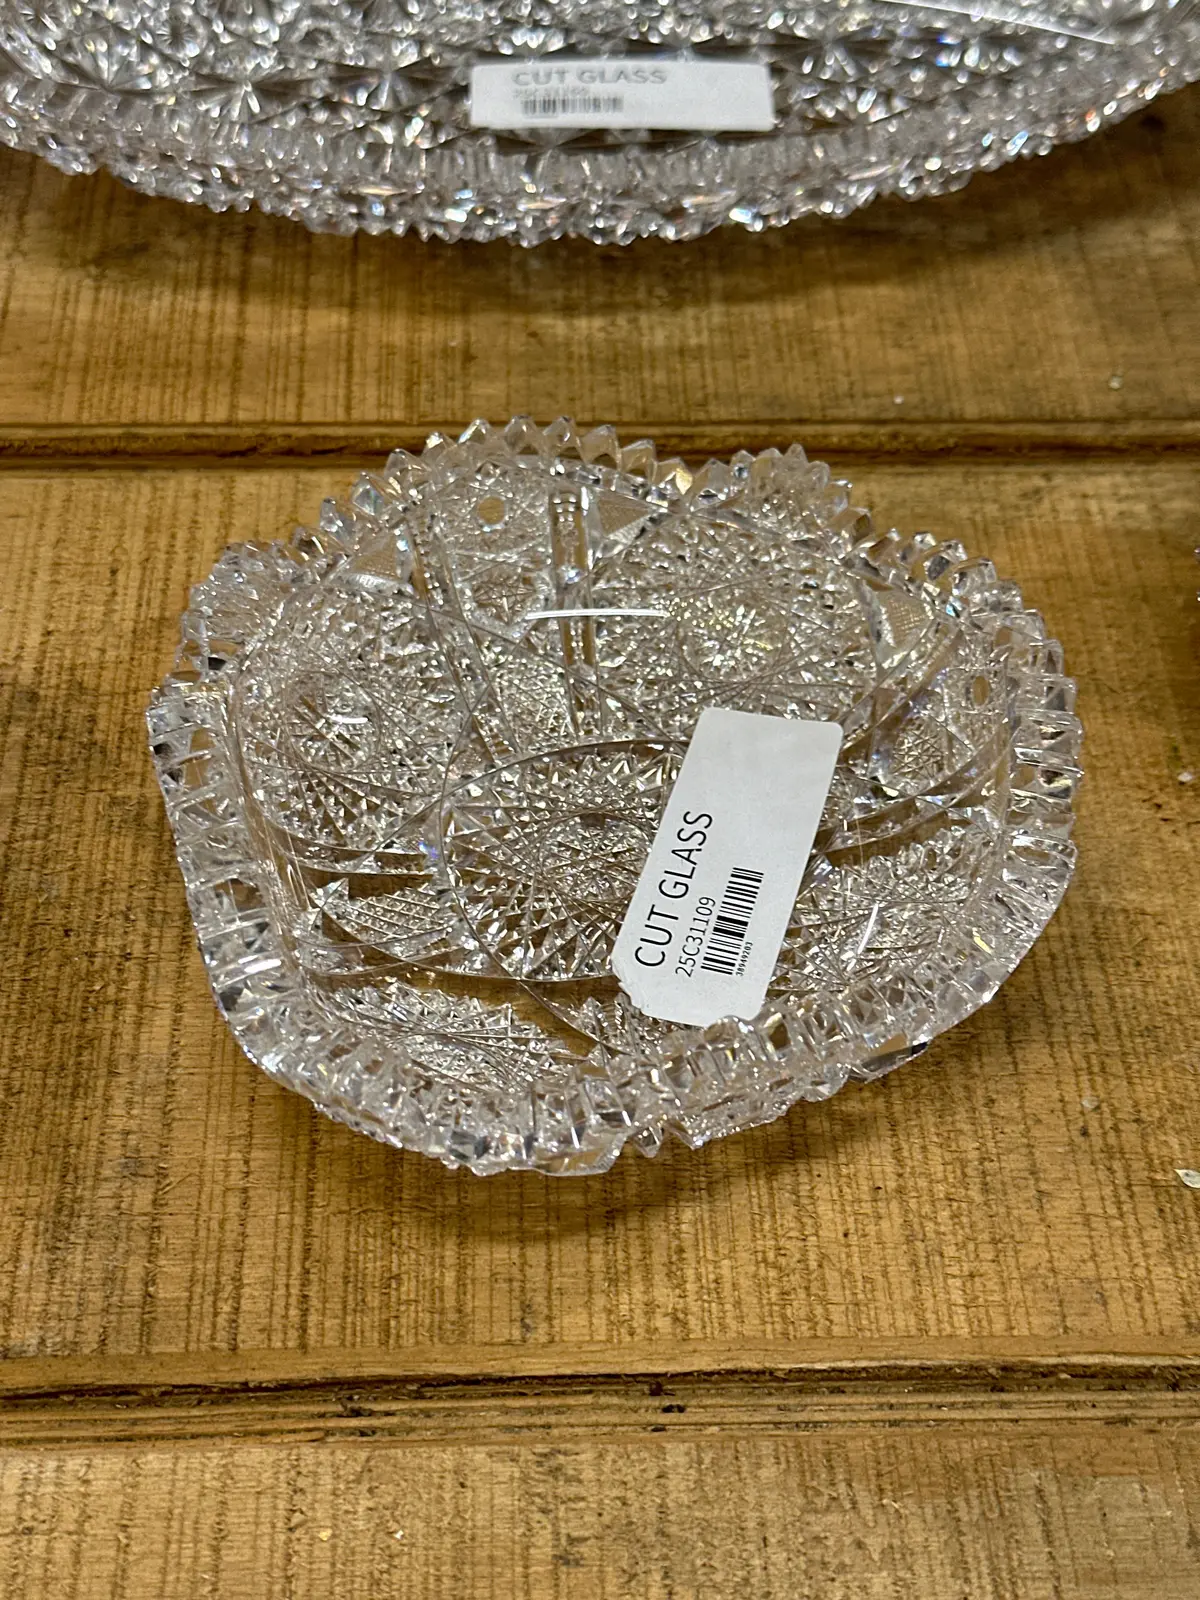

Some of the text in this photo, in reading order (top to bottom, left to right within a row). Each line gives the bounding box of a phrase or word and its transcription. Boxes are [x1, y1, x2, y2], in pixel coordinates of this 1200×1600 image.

[512, 68, 668, 86] CUT GLASS
[634, 811, 713, 967] CUT GLASS
[675, 896, 716, 977] 25C31109
